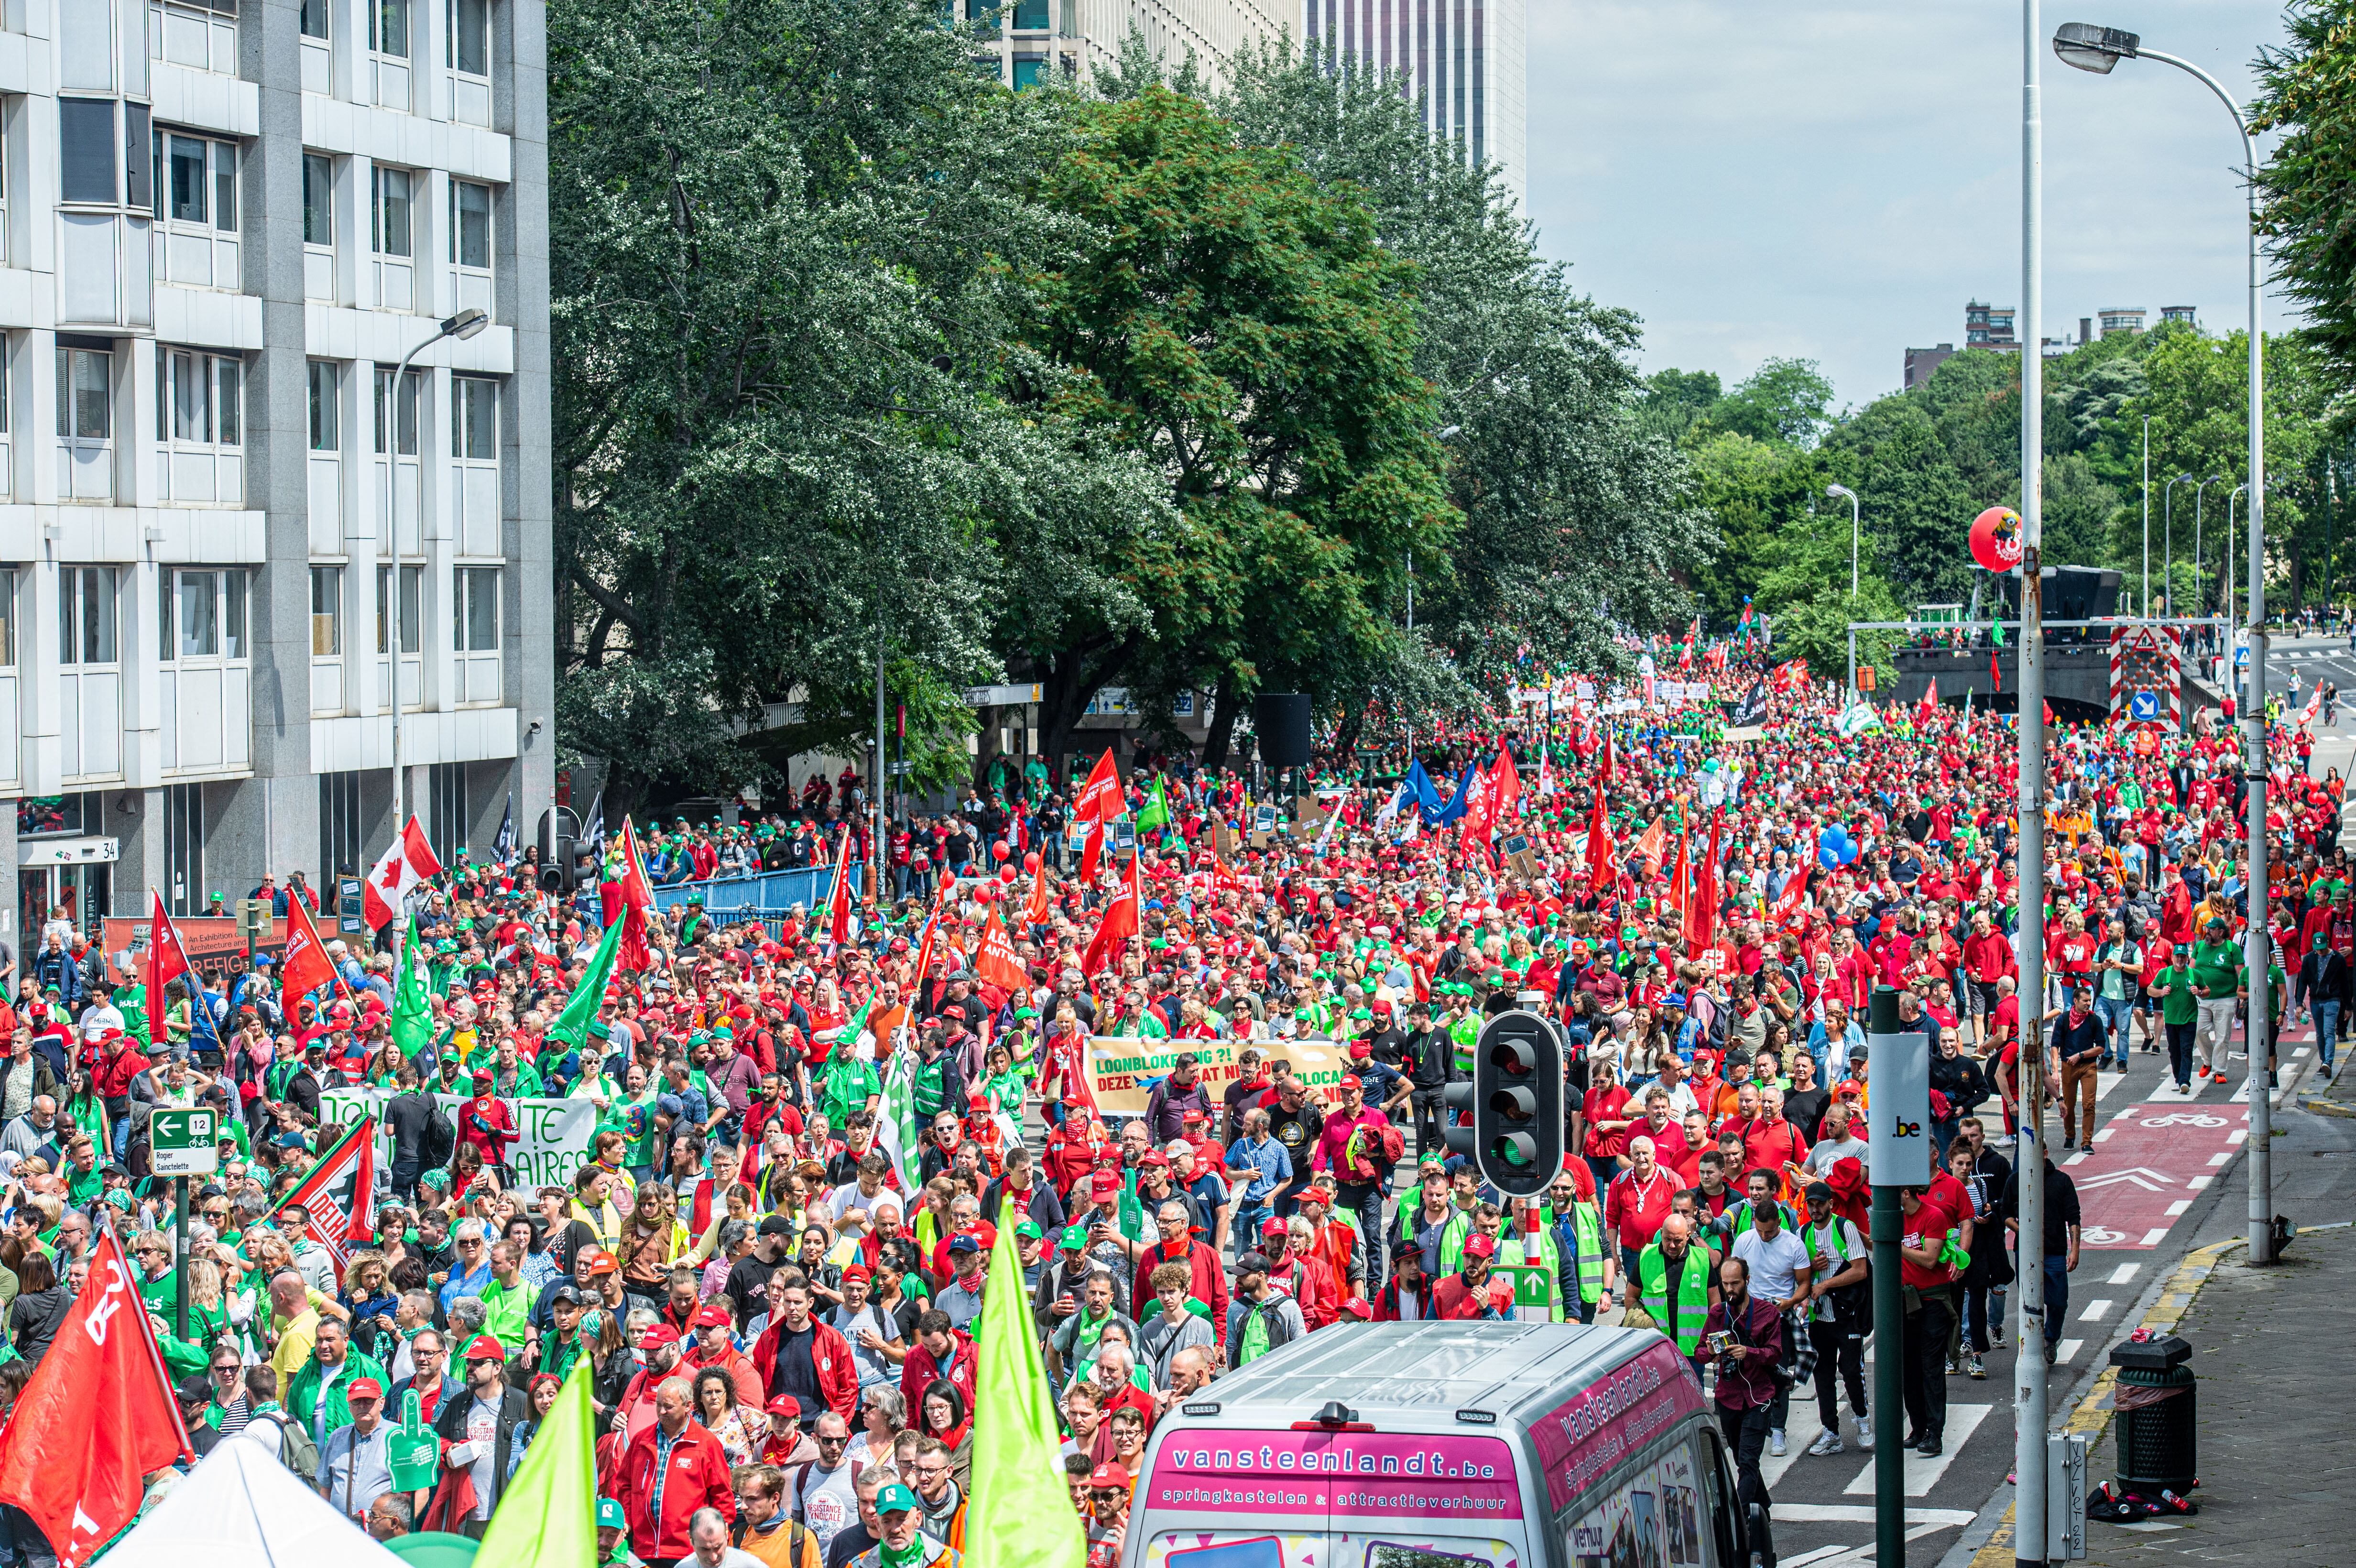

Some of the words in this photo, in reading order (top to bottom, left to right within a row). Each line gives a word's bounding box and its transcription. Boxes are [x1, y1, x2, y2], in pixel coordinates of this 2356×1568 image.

[104, 842, 115, 859] 34
[190, 942, 232, 952] Architecture
[255, 935, 284, 944] ansitions
[199, 933, 232, 942] Exhibition
[1216, 1048, 1232, 1062] ?!
[1098, 1076, 1133, 1092] DEZE
[1294, 1070, 1344, 1086] BLOCA
[194, 1120, 206, 1129] 12
[1892, 1116, 1920, 1138] .be
[156, 1152, 173, 1161] Rogier
[1560, 1361, 1660, 1445] vansteenlandt.be
[467, 1426, 496, 1434] RÉSISTANC
[1565, 1438, 1619, 1490] springkastelen
[1625, 1397, 1675, 1445] attractieverhuur
[1173, 1447, 1495, 1479] vansteenlandt.be
[1162, 1489, 1307, 1506] springkastelen
[1315, 1494, 1326, 1505] &
[1338, 1494, 1506, 1510] attractieverhuur
[807, 1503, 842, 1513] RÉSISTANCE
[1573, 1522, 1603, 1548] verhuur
